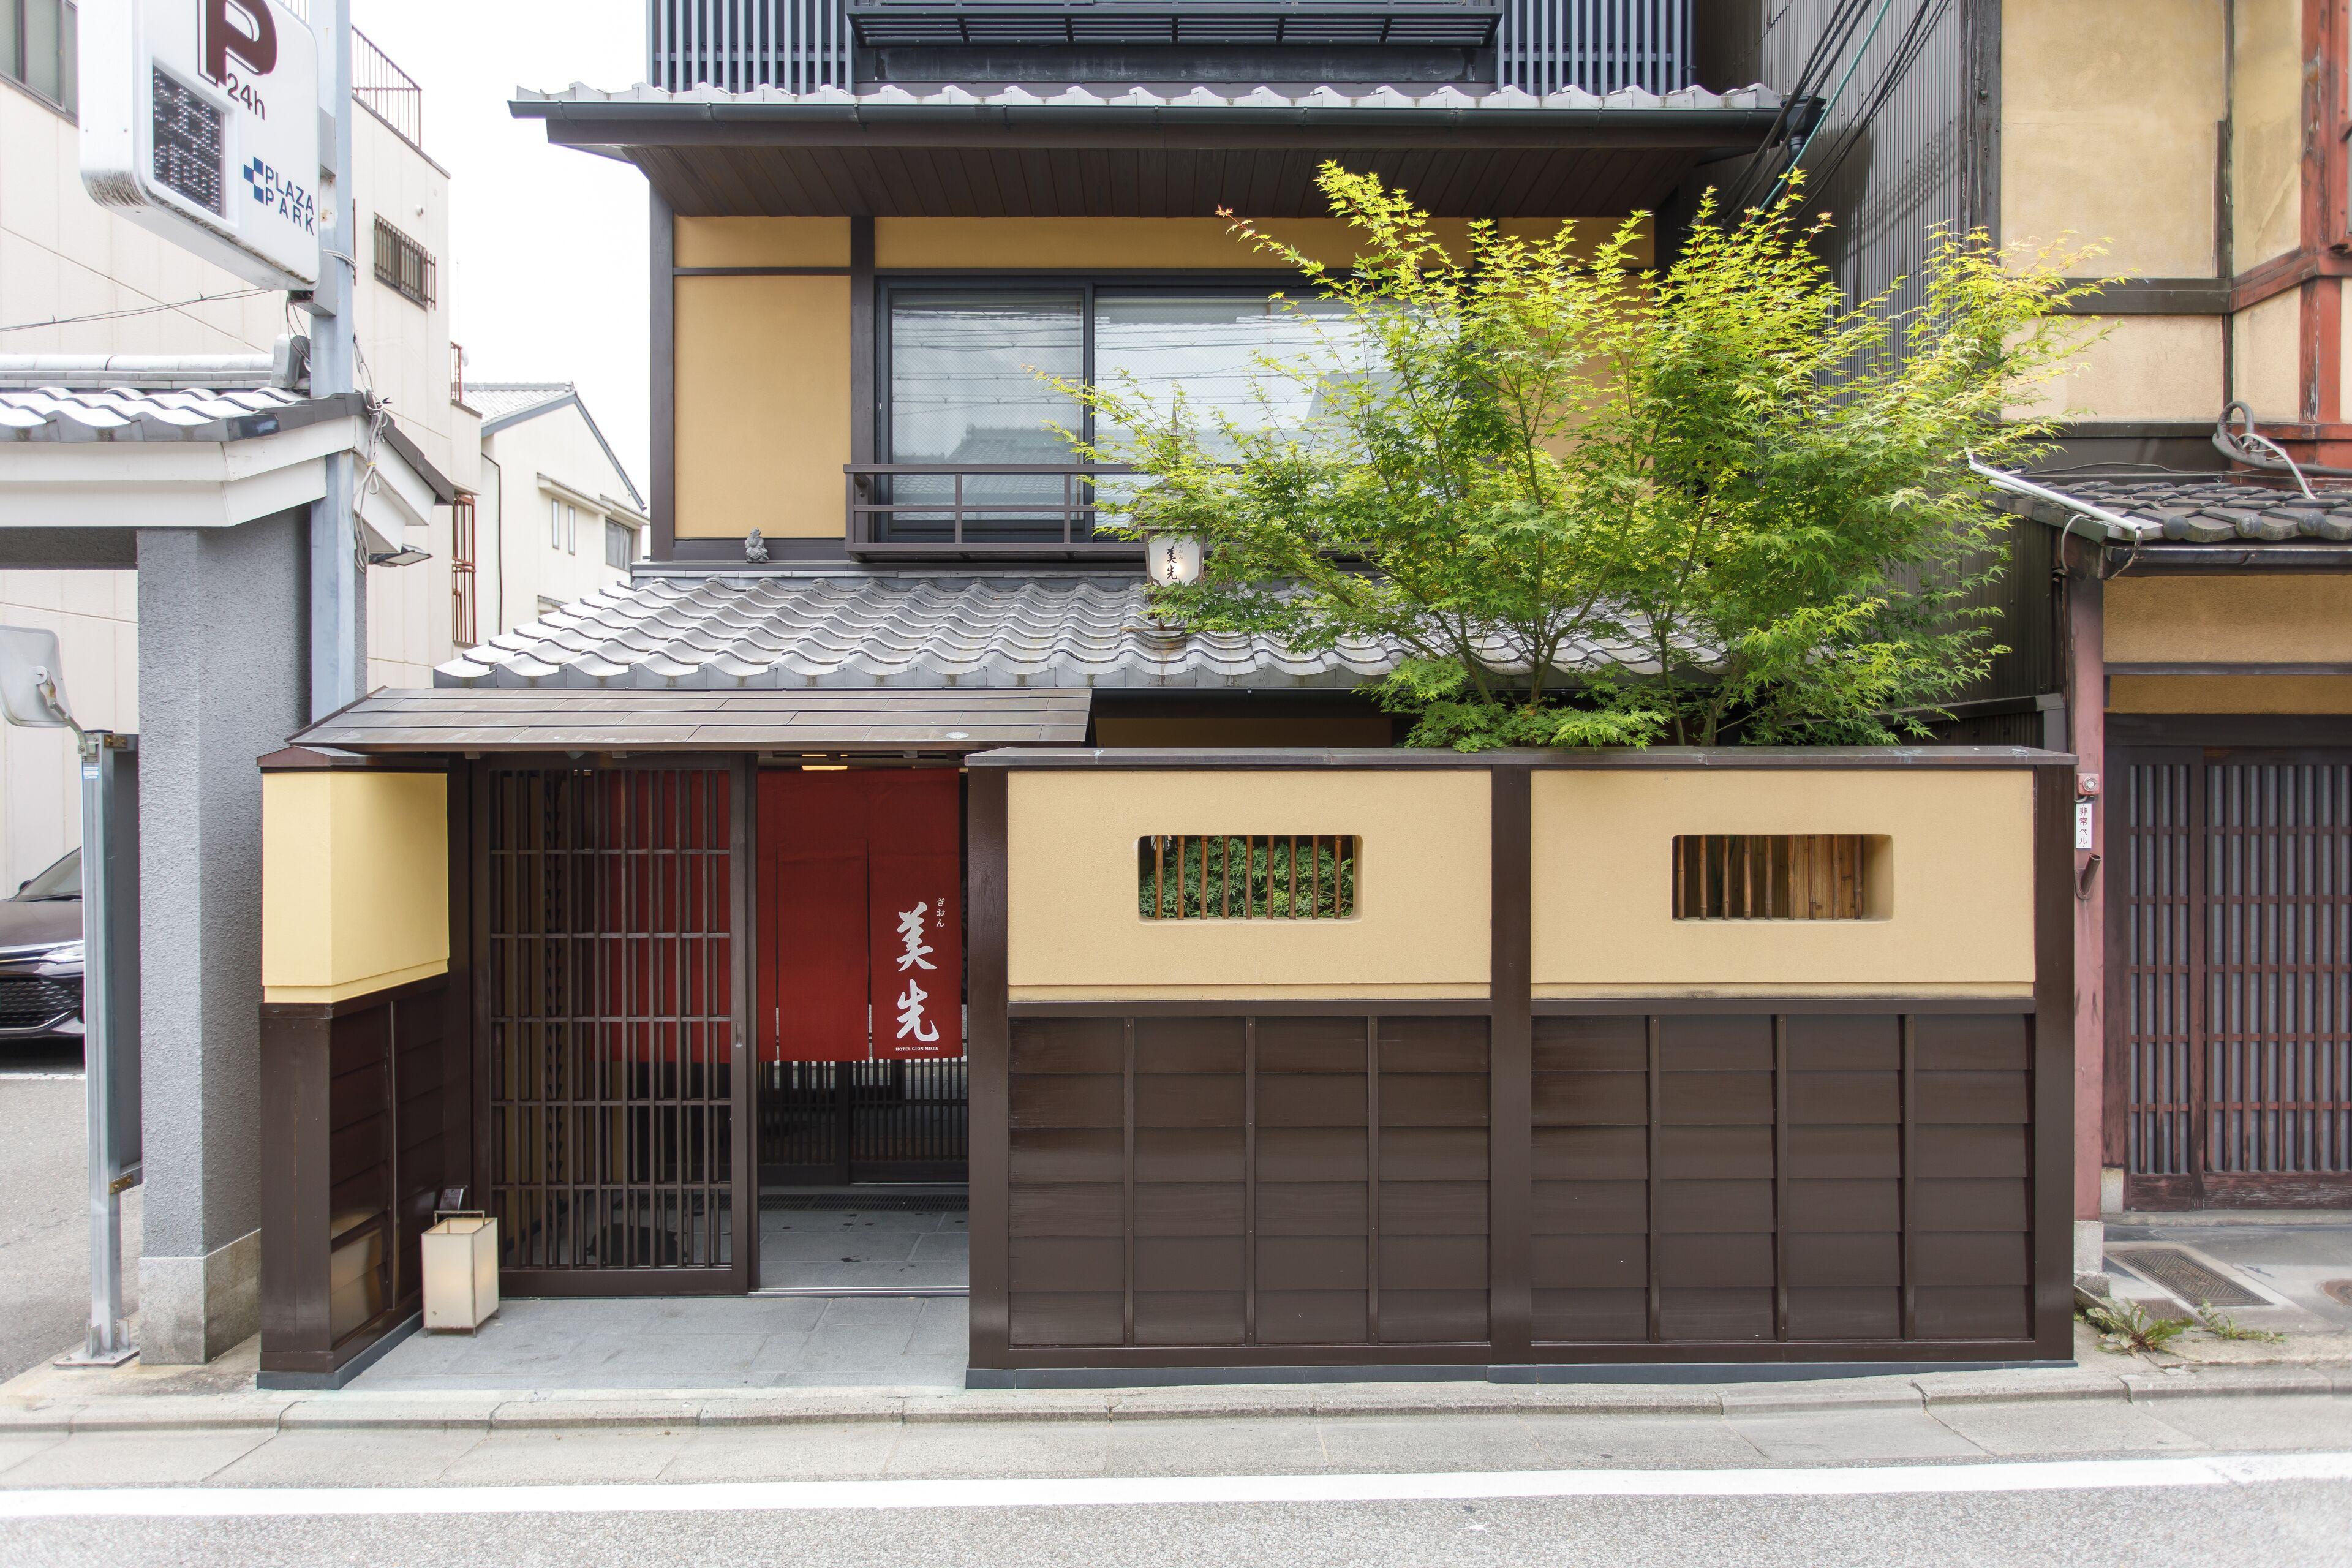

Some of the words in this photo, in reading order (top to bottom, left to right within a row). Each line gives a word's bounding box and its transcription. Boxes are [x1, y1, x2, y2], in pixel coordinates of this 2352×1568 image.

[197, 0, 278, 88] P
[227, 72, 265, 121] 24h
[265, 165, 314, 216] PLAZA
[265, 186, 314, 236] PARK
[1167, 546, 1178, 580] 美先
[936, 897, 946, 928] ぎおん
[896, 901, 940, 1042] 美先
